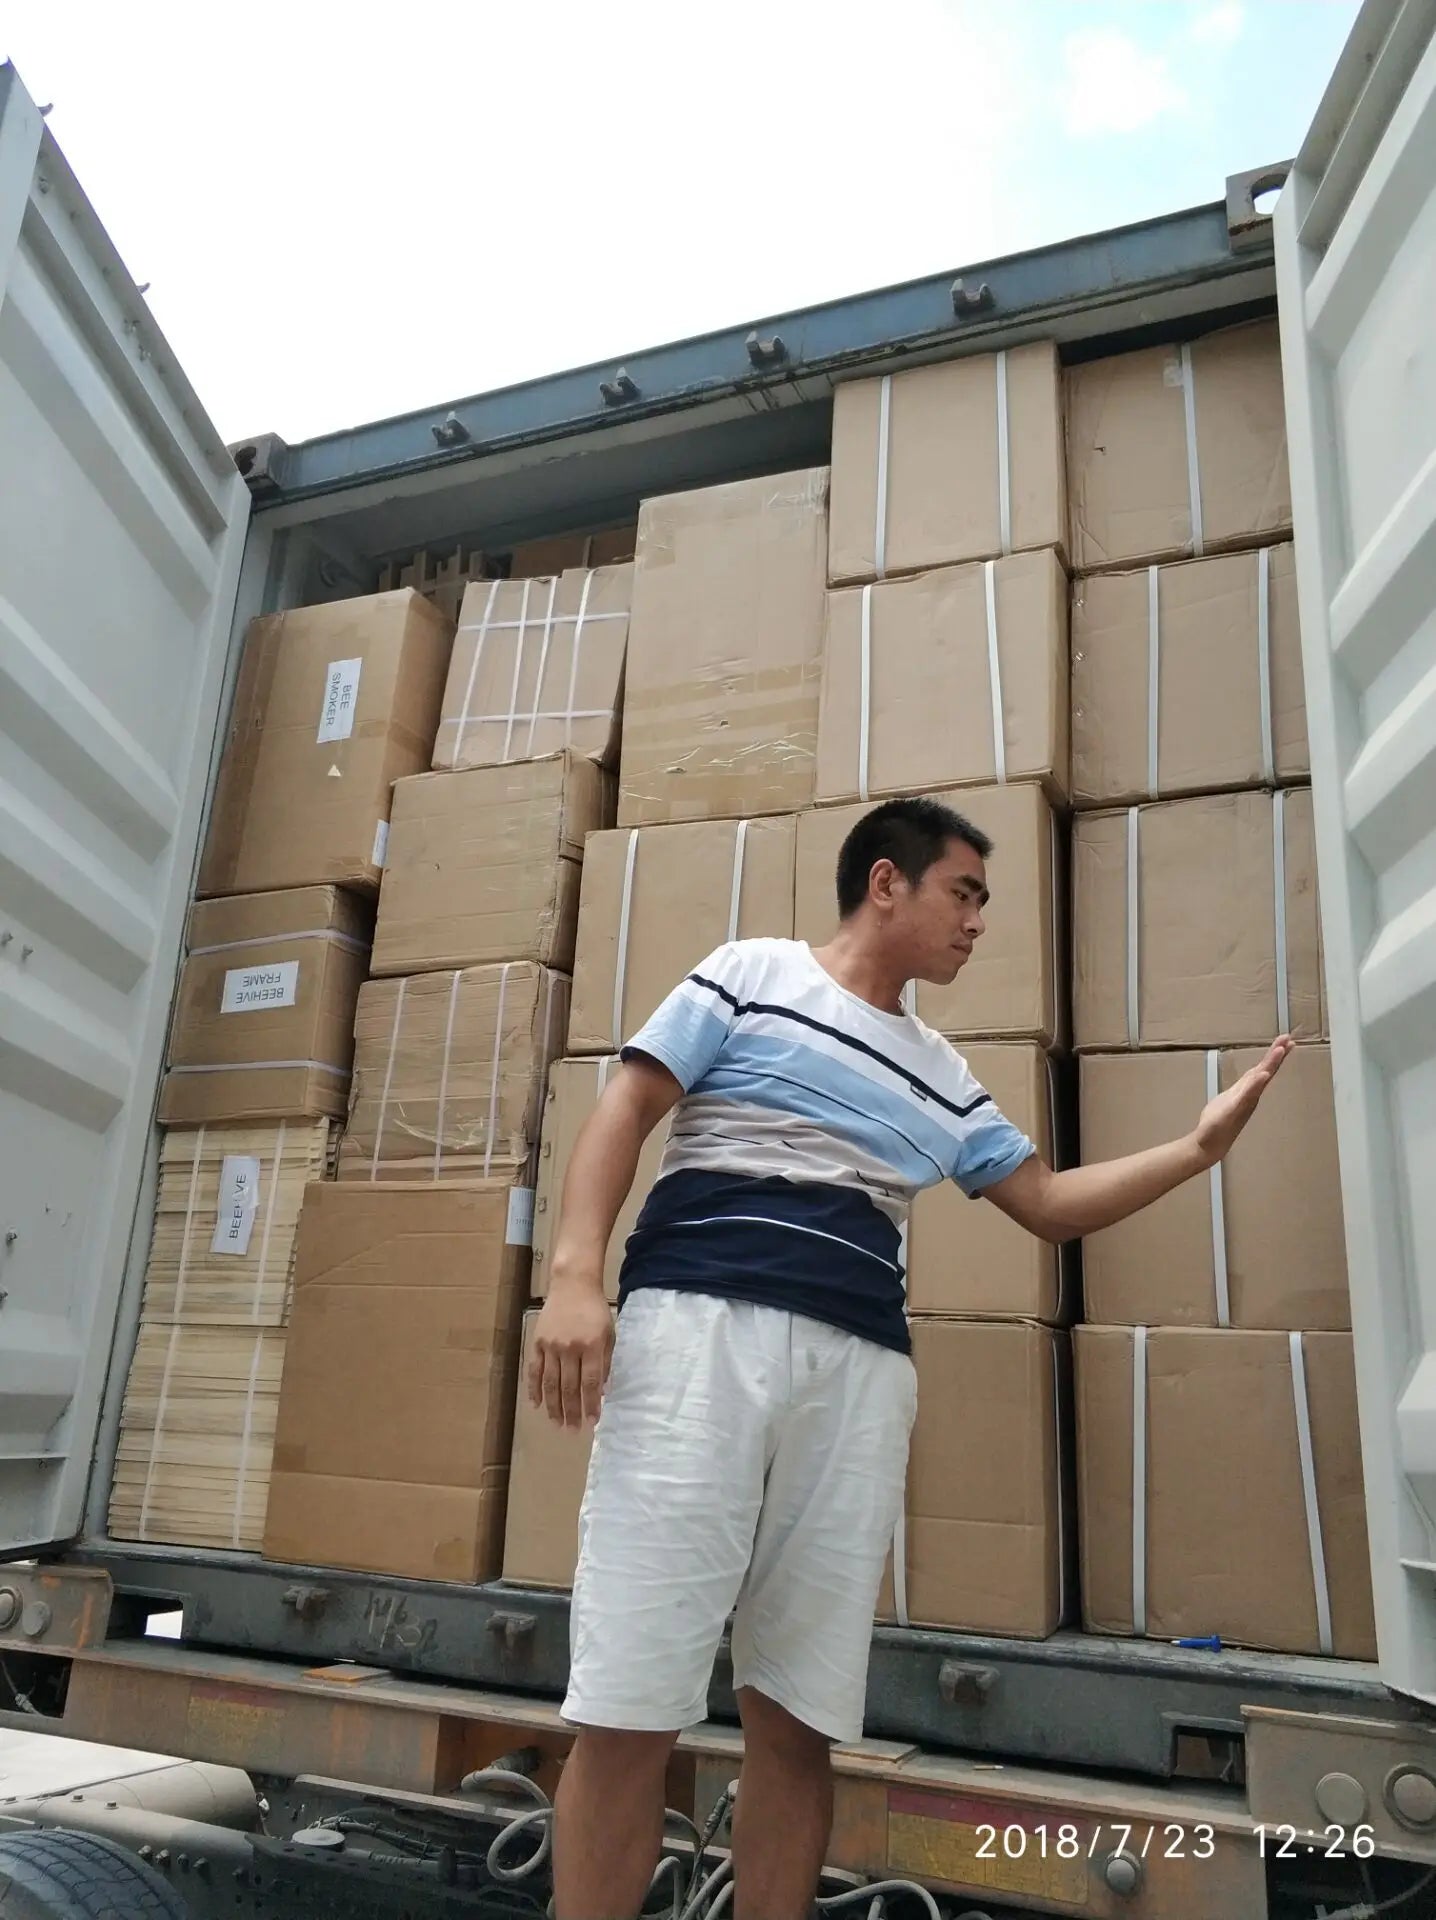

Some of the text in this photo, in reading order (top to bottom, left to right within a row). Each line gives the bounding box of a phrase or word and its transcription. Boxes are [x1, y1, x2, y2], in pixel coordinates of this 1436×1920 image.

[326, 672, 342, 727] SMOKER
[340, 684, 352, 711] BEE
[242, 971, 281, 988] FRAME
[235, 987, 285, 1004] BEEHIVE
[228, 1174, 247, 1240] BEEHVE
